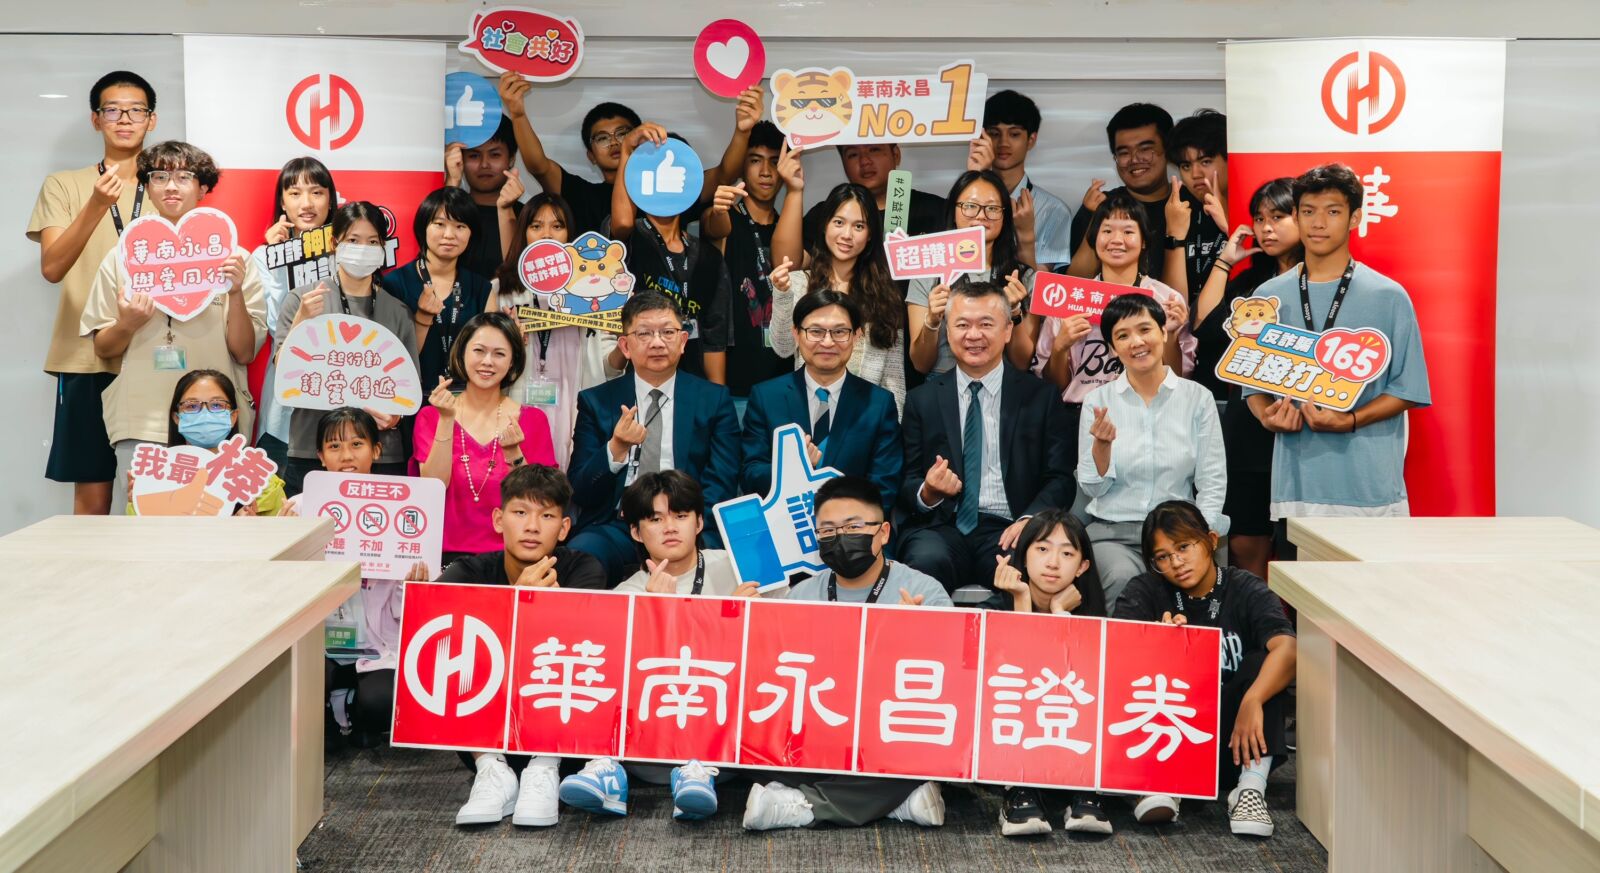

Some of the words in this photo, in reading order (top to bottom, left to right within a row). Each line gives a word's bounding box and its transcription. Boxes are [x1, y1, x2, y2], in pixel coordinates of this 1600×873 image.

[481, 26, 574, 63] 社會共好
[856, 79, 931, 99] 華南永昌
[857, 63, 977, 138] No.1
[890, 177, 905, 232] #公益行
[132, 233, 223, 264] 華南永昌
[894, 243, 957, 272] 超讚!
[130, 267, 228, 293] 與愛同行
[1067, 303, 1084, 313] HUA
[1261, 328, 1316, 353] 反詐騙
[312, 350, 382, 368] 一起行動
[1321, 335, 1380, 378] 165
[300, 369, 397, 405] 讓愛傳遞
[134, 436, 275, 504] 我最棒
[346, 482, 404, 499] 反詐三不
[359, 539, 383, 552] 不加
[397, 541, 421, 554] 不用
[518, 635, 1215, 762] 華南永昌證券
